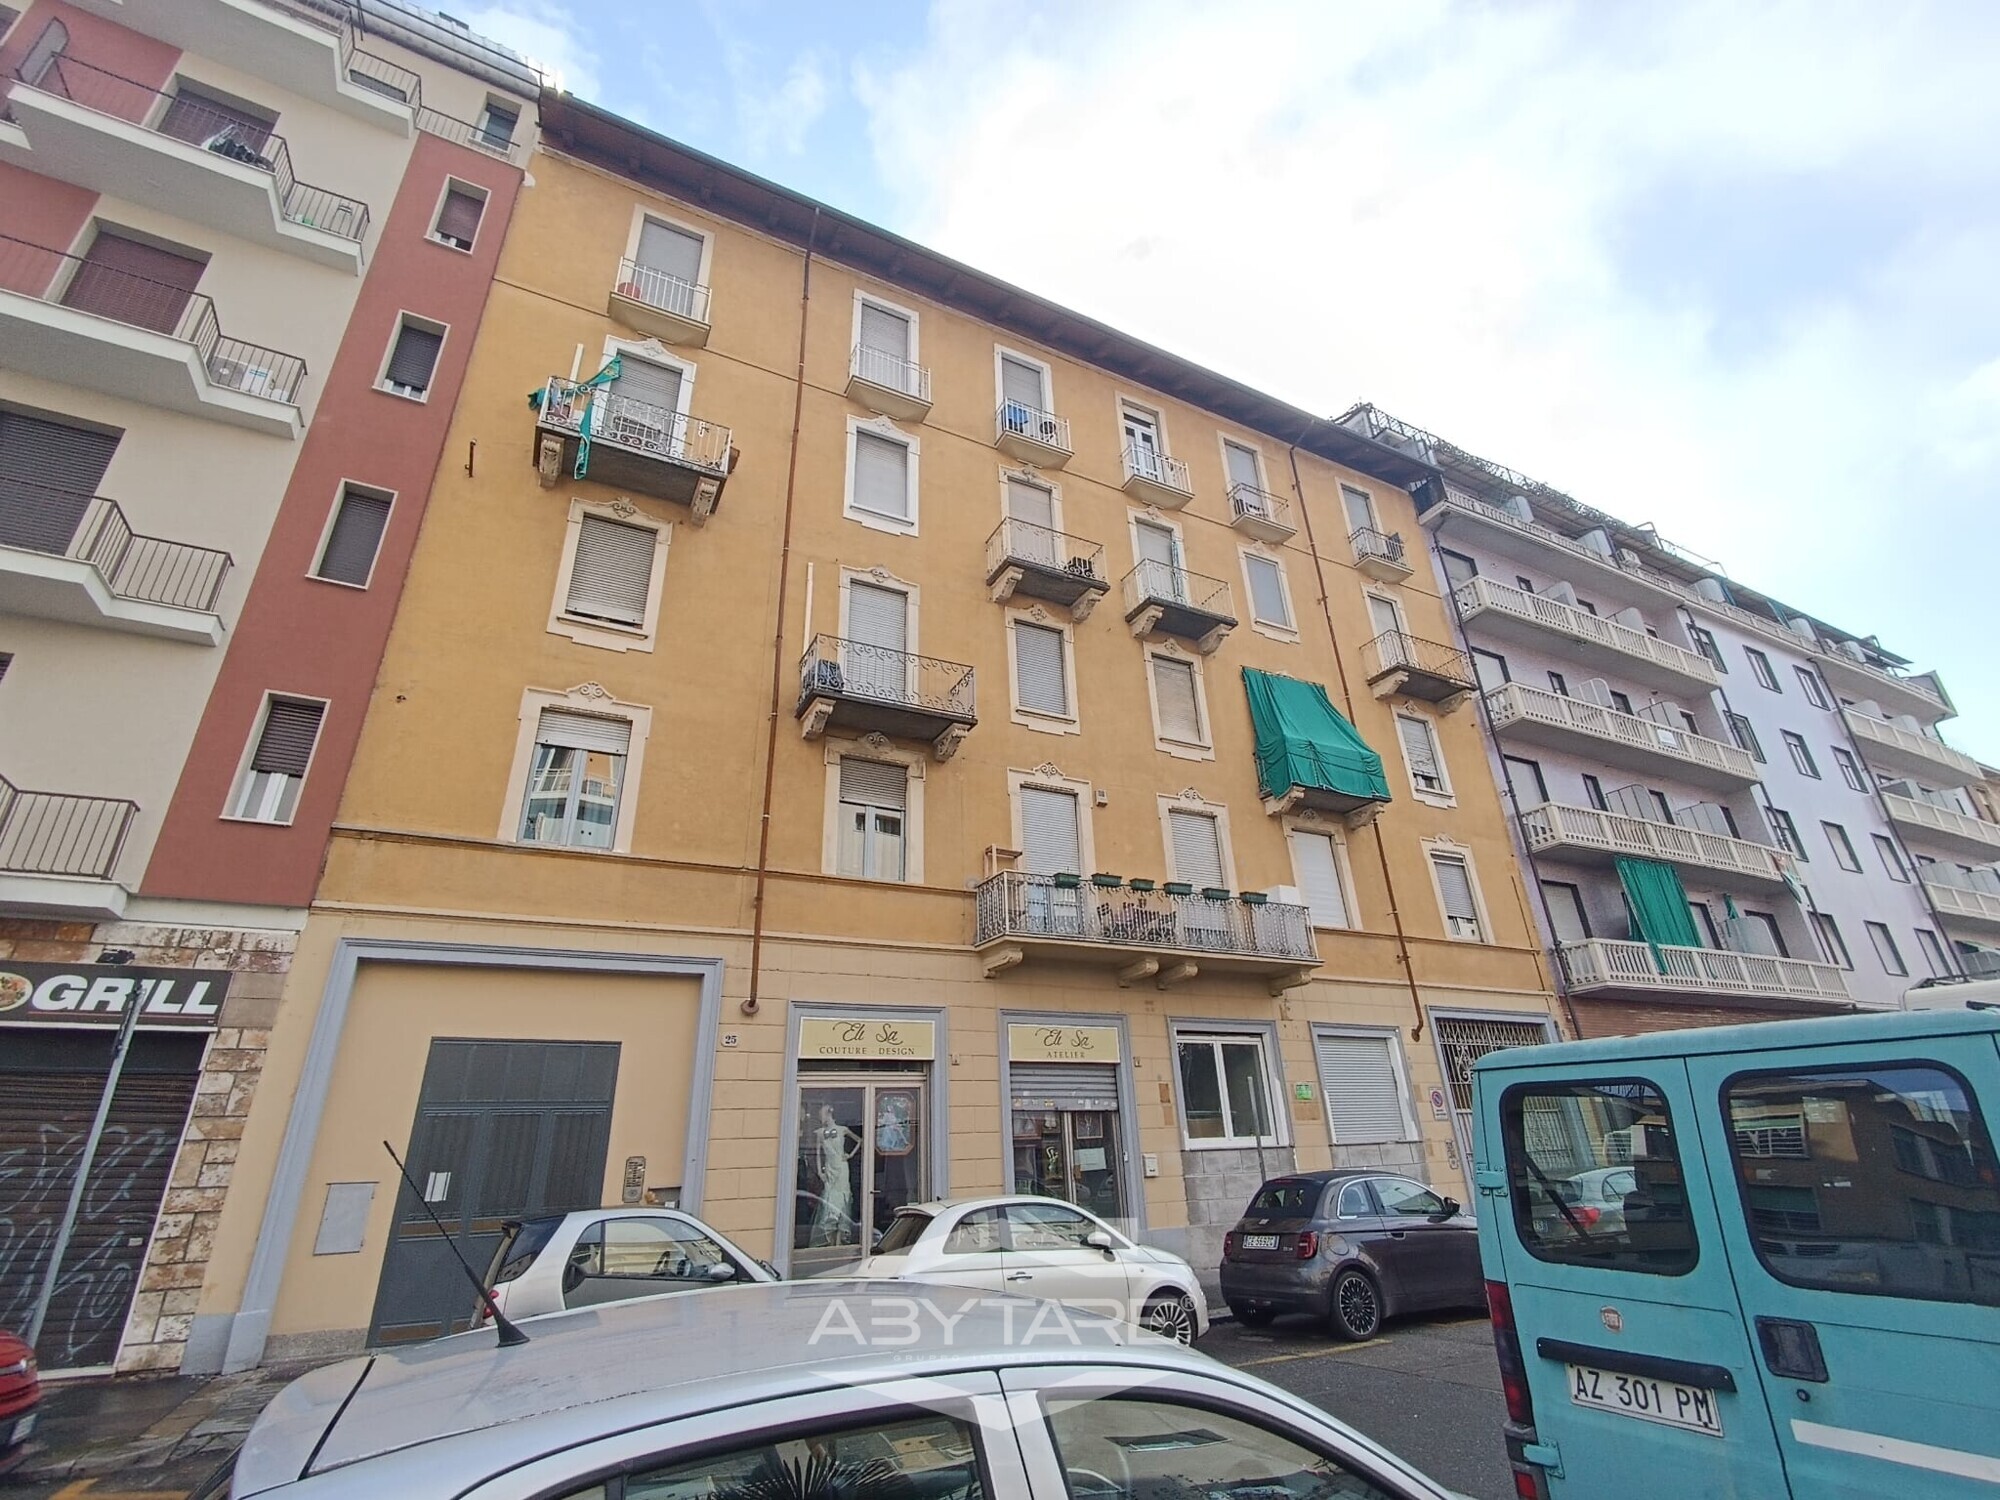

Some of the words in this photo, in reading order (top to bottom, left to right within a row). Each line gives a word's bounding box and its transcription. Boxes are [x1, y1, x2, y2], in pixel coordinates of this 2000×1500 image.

[875, 1023, 904, 1045] Sa
[1071, 1030, 1094, 1049] Sa
[819, 1046, 867, 1055] COUTURE
[879, 1047, 915, 1056] DESIGN
[1577, 1368, 1603, 1400] AZ
[1615, 1376, 1662, 1413] 301
[1675, 1387, 1713, 1424] PM
